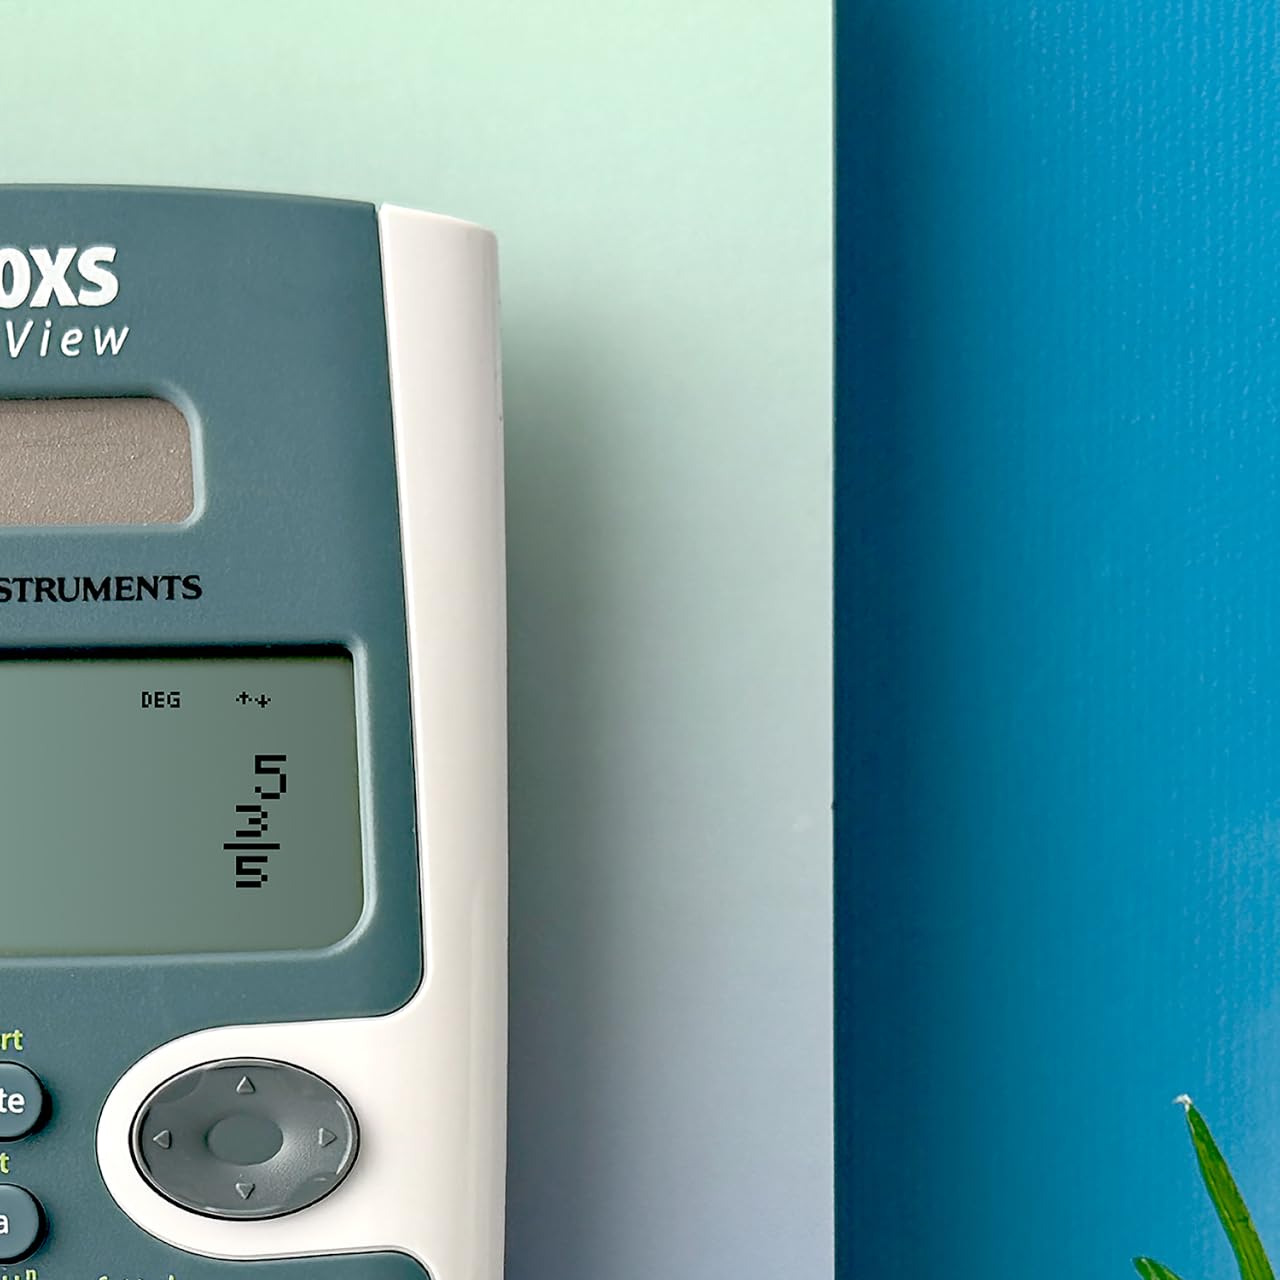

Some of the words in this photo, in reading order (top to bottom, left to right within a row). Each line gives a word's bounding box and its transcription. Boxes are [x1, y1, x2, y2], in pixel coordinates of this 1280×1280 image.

[141, 691, 181, 709] DEG
[254, 754, 287, 800] 5
[235, 804, 269, 838] 3
[235, 855, 269, 889] 5
